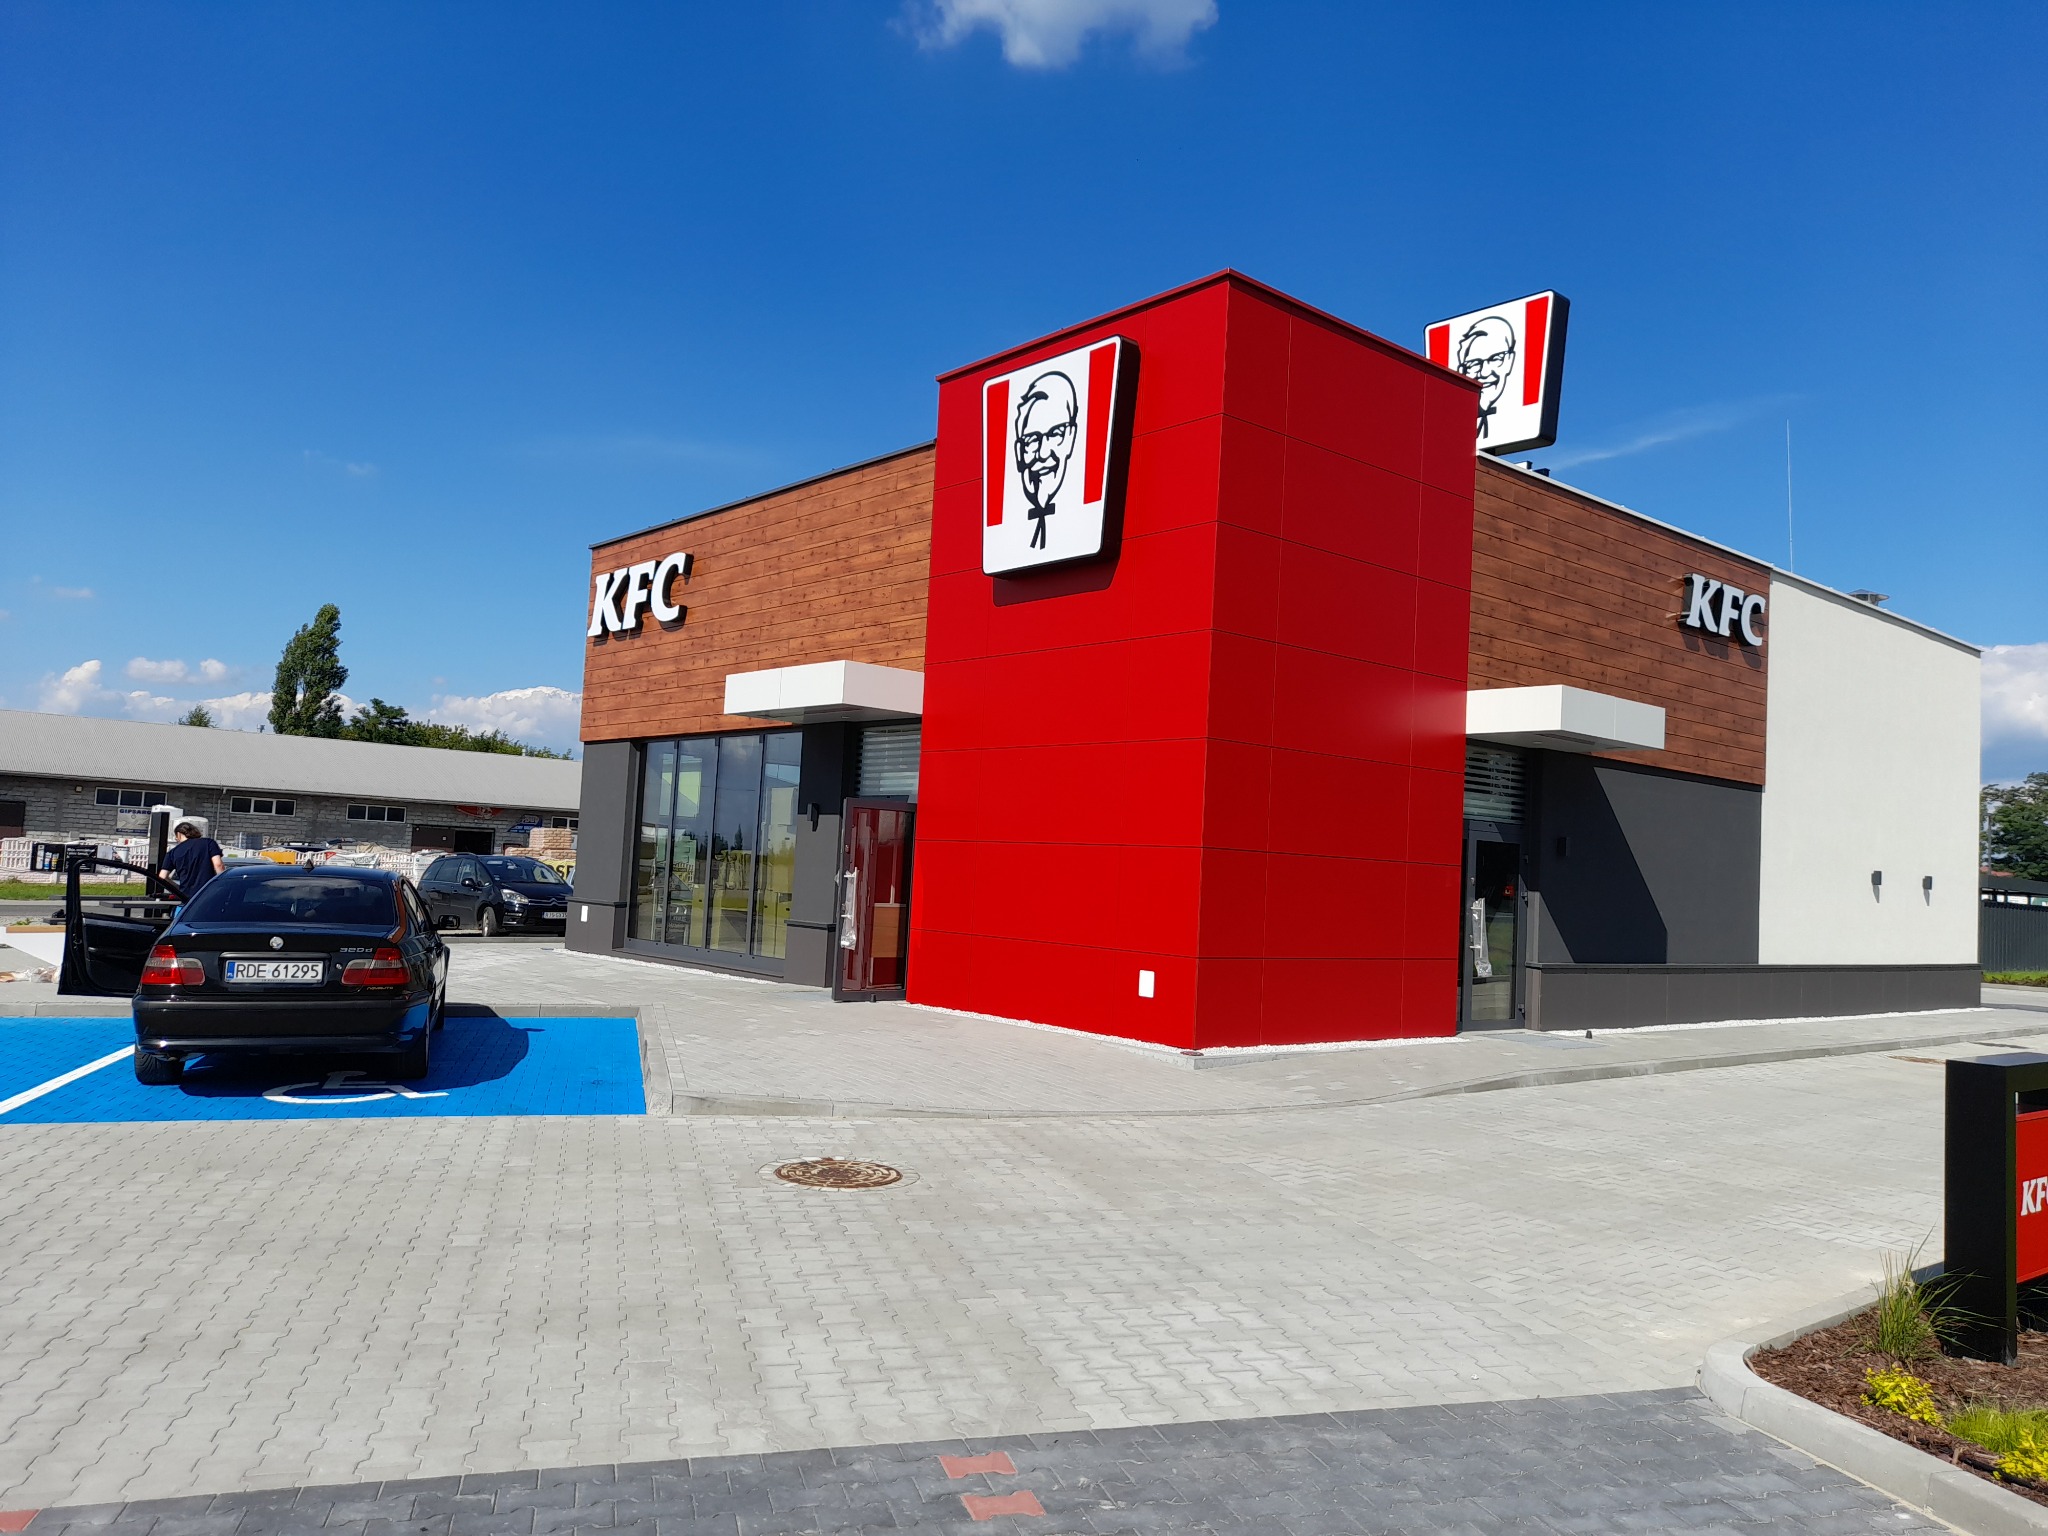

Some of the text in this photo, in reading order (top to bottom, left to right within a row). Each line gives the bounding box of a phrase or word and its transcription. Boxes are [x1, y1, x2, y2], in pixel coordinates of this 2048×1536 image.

[587, 552, 688, 637] KFC
[1686, 573, 1767, 647] KFC
[236, 963, 319, 978] RDE 61295
[2020, 1175, 2048, 1217] KF
